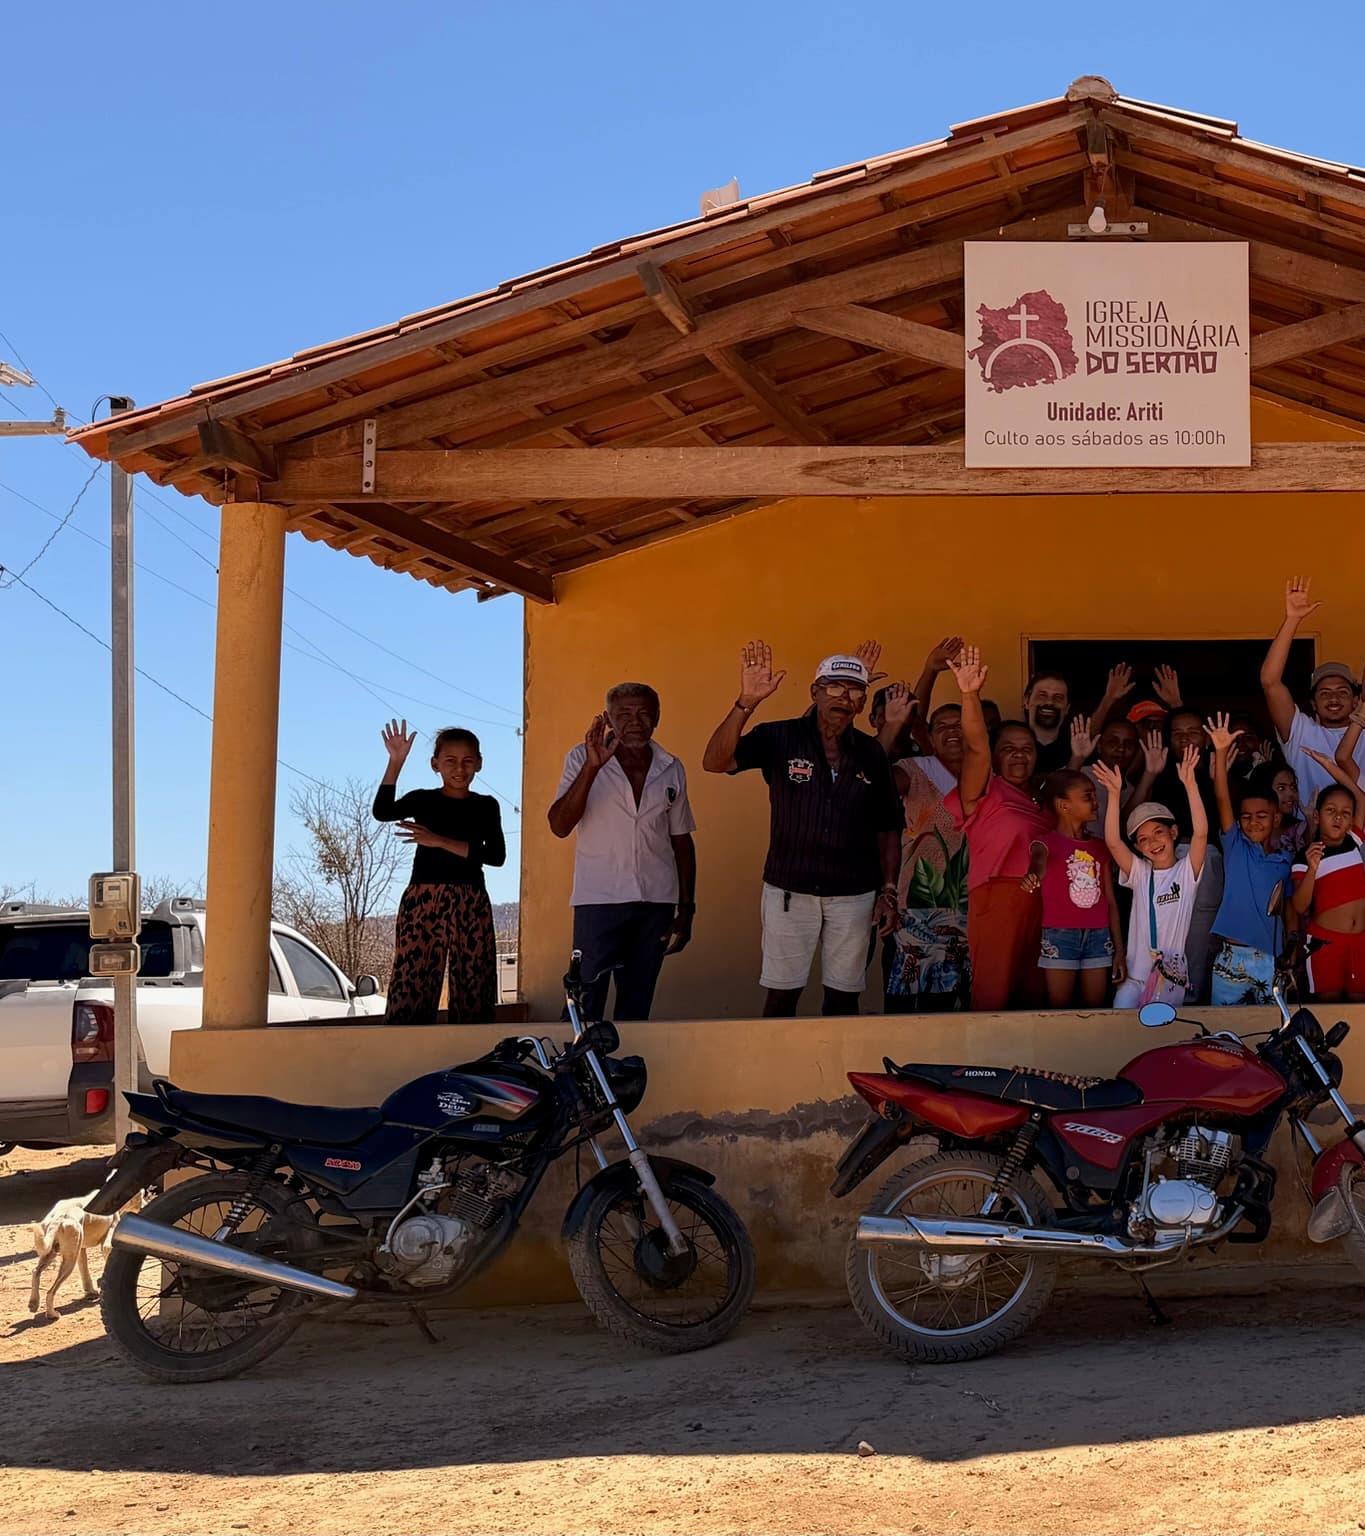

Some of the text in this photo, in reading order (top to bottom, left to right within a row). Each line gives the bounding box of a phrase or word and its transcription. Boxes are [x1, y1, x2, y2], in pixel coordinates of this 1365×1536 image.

[1086, 300, 1169, 324] IGREJA
[1086, 319, 1240, 347] MISSIONÁRIA
[1086, 345, 1217, 376] DO SERTÃO
[1047, 401, 1163, 422] Unidade: Ariti
[984, 429, 1226, 446] Culto aos sábados as 10:00h
[965, 1070, 997, 1078] HONDA
